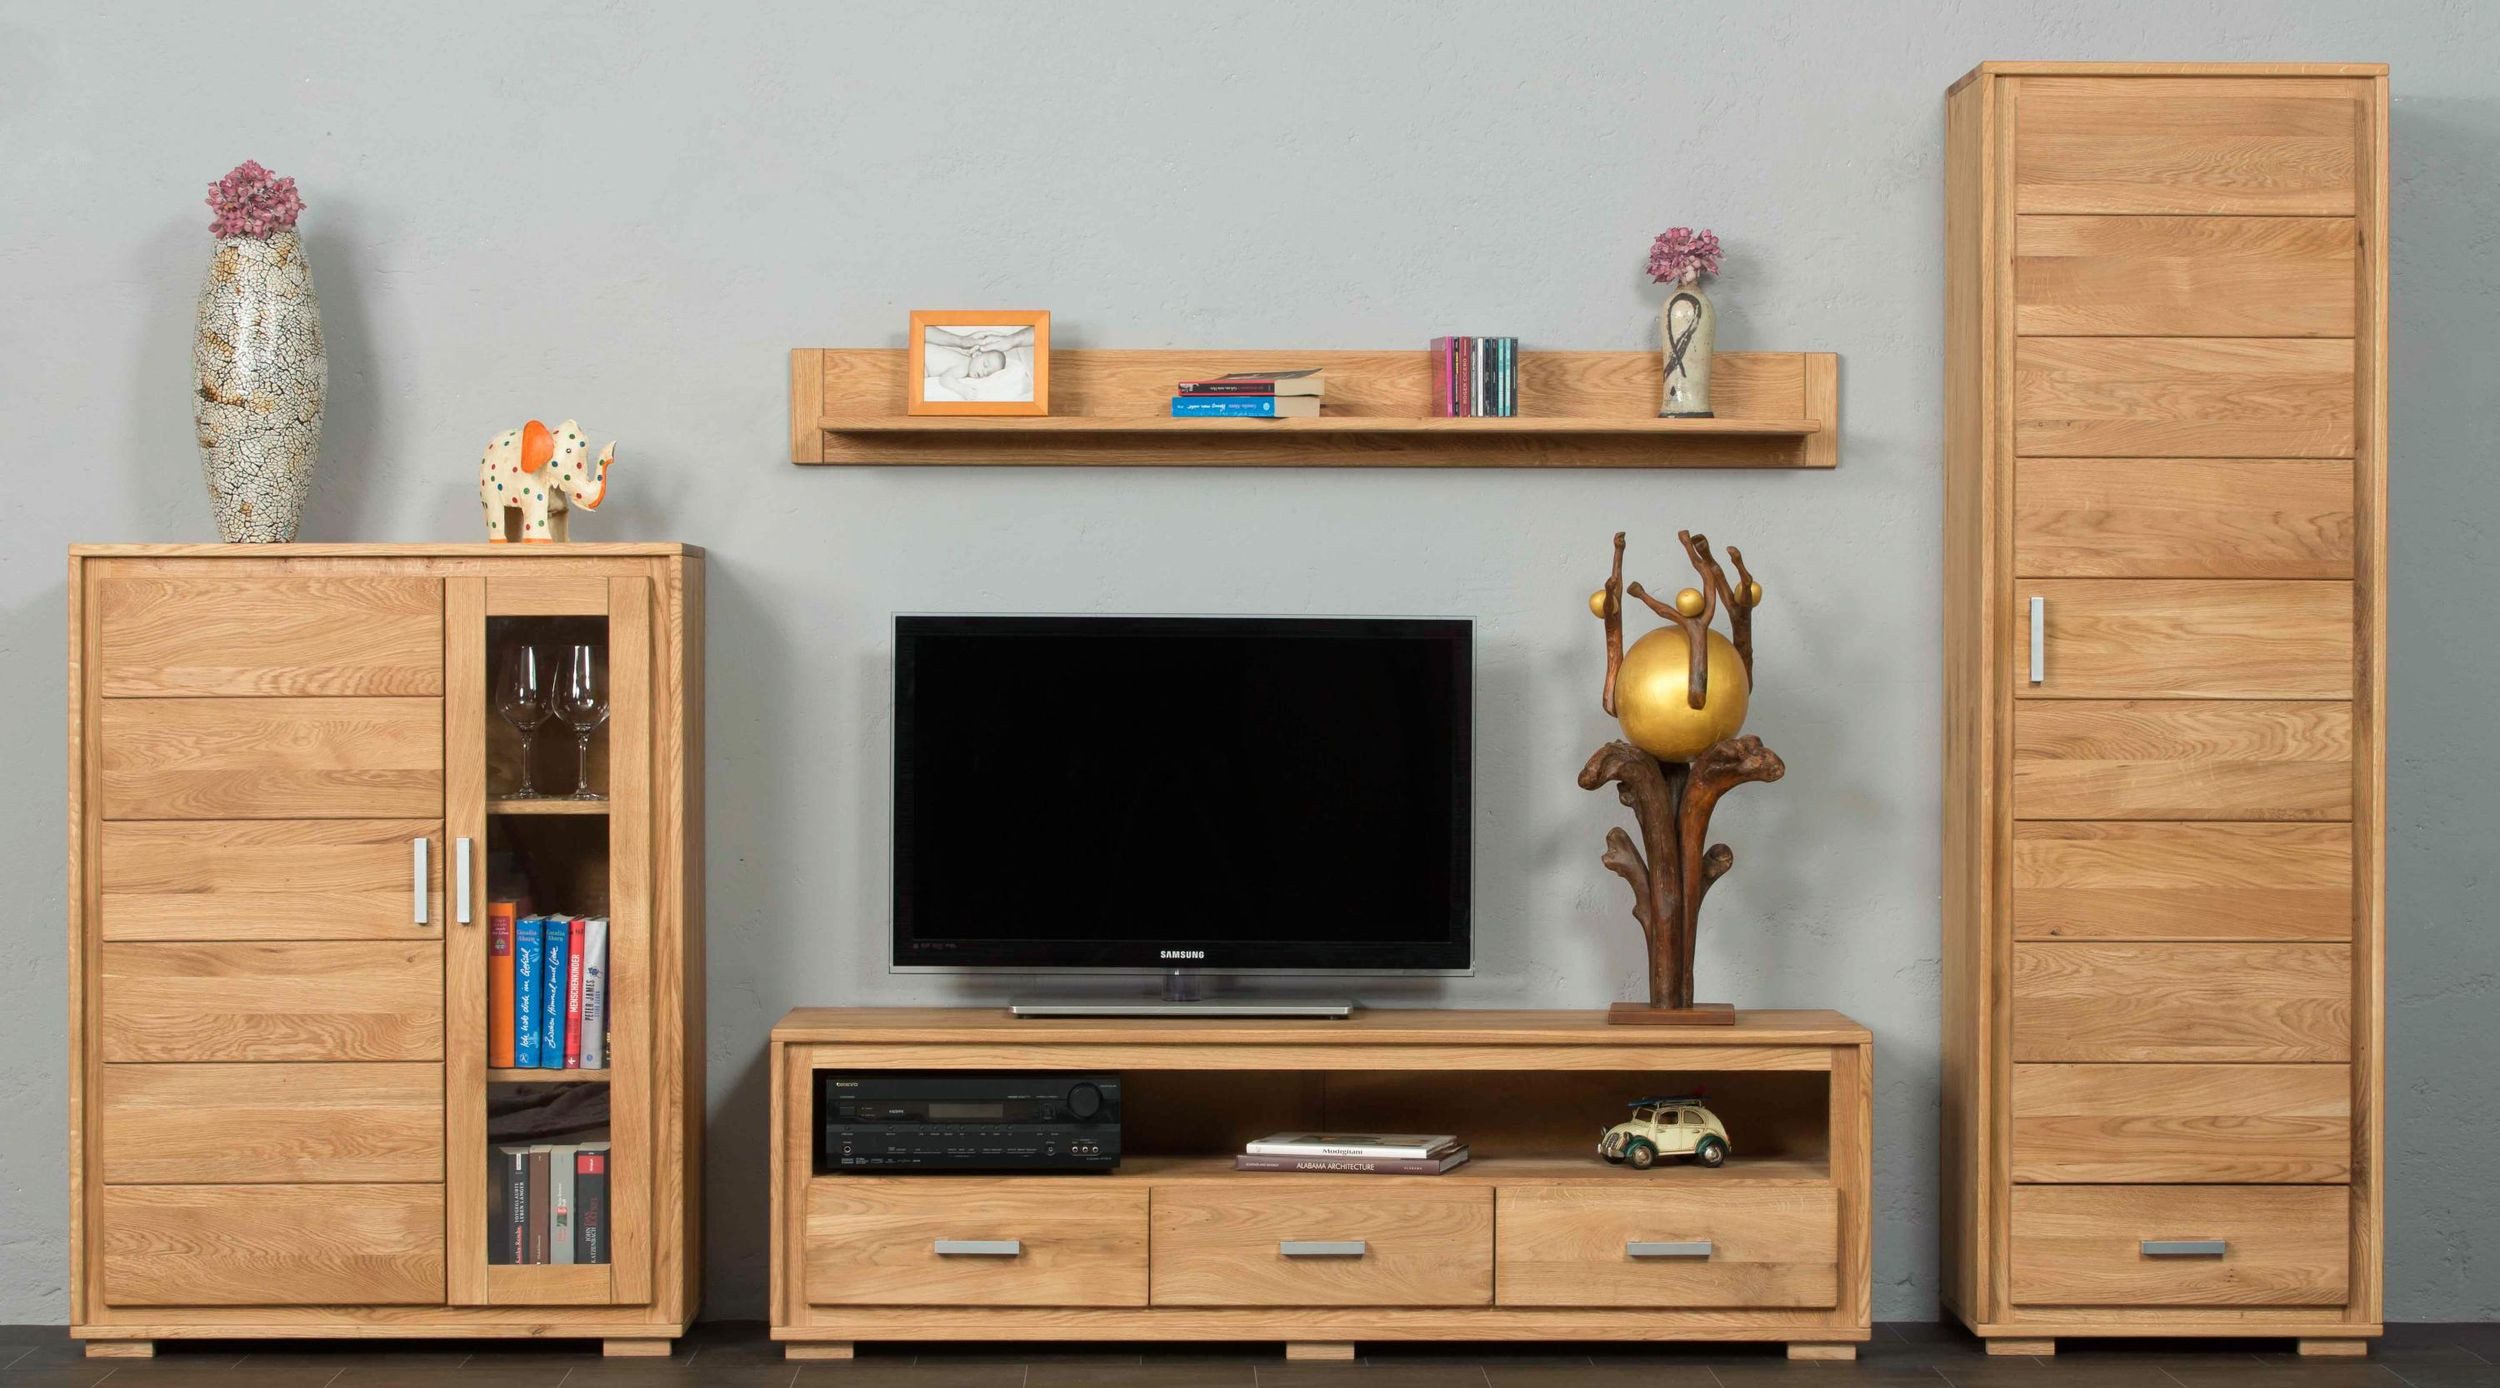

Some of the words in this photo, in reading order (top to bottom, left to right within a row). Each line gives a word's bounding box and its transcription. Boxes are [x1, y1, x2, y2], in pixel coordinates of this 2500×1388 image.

[1160, 950, 1205, 959] SAMSUNG
[569, 954, 581, 1013] MENSCHENKINDER
[585, 979, 595, 1001] JAMES
[584, 1003, 594, 1021] PETER
[520, 1033, 530, 1047] Ich
[1296, 1162, 1327, 1170] ALABAMA
[1327, 1162, 1375, 1171] ARCHITECTURE
